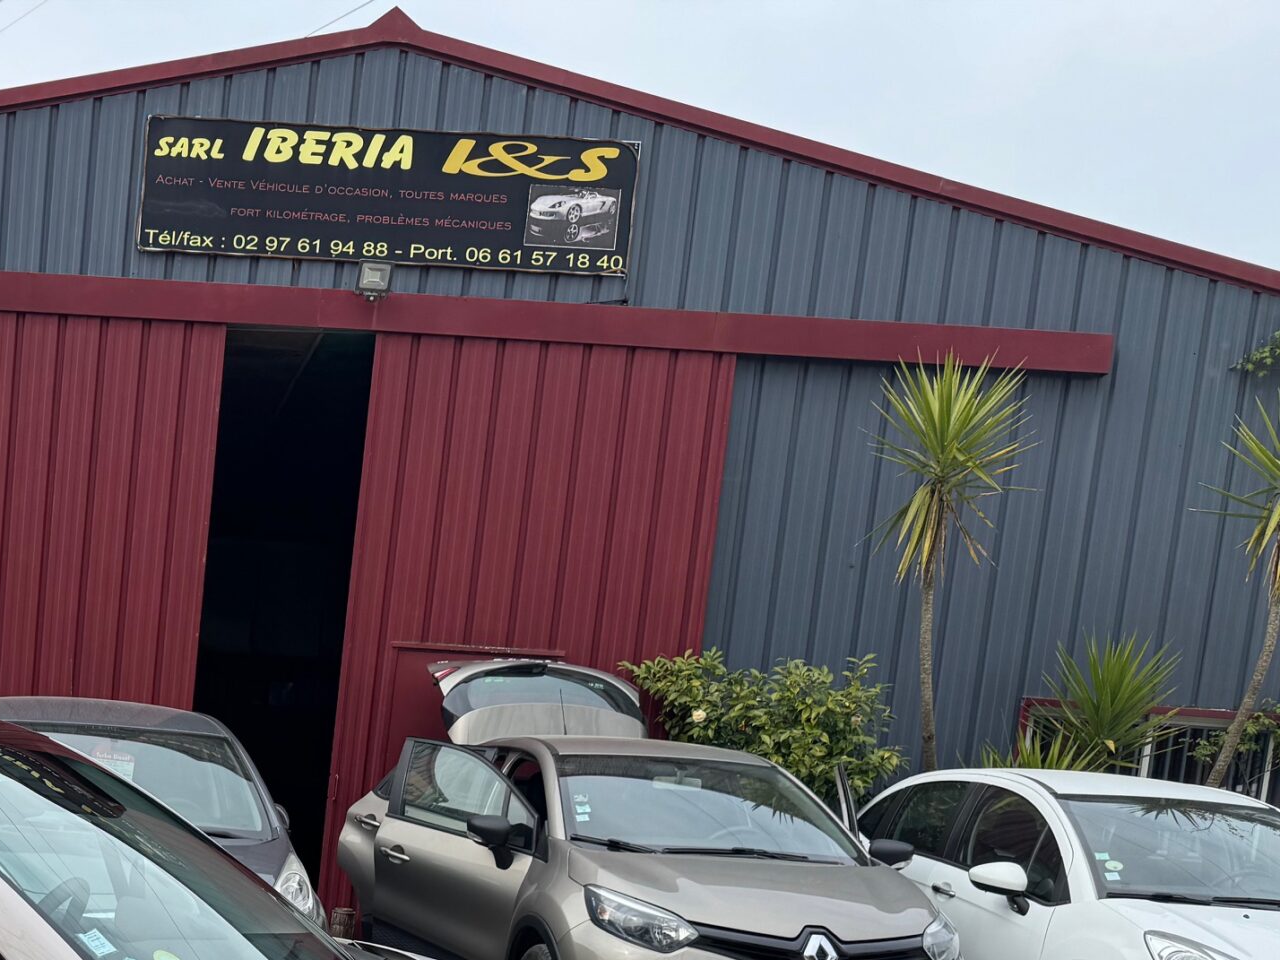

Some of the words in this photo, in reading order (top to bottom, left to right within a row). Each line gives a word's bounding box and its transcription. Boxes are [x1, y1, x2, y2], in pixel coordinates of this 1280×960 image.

[154, 136, 224, 160] SARL
[242, 126, 414, 171] IBERIA
[442, 138, 621, 182] I&S
[145, 229, 214, 248] Tél/fax
[233, 234, 258, 250] 02
[265, 237, 292, 252] 97
[297, 238, 321, 253] 61
[330, 240, 355, 255] 94
[362, 241, 388, 257] 88
[409, 244, 457, 261] Port.
[465, 247, 491, 263] 06
[498, 249, 522, 264] 61
[531, 251, 558, 266] 57
[566, 253, 590, 268] 18
[596, 255, 623, 270] 40
